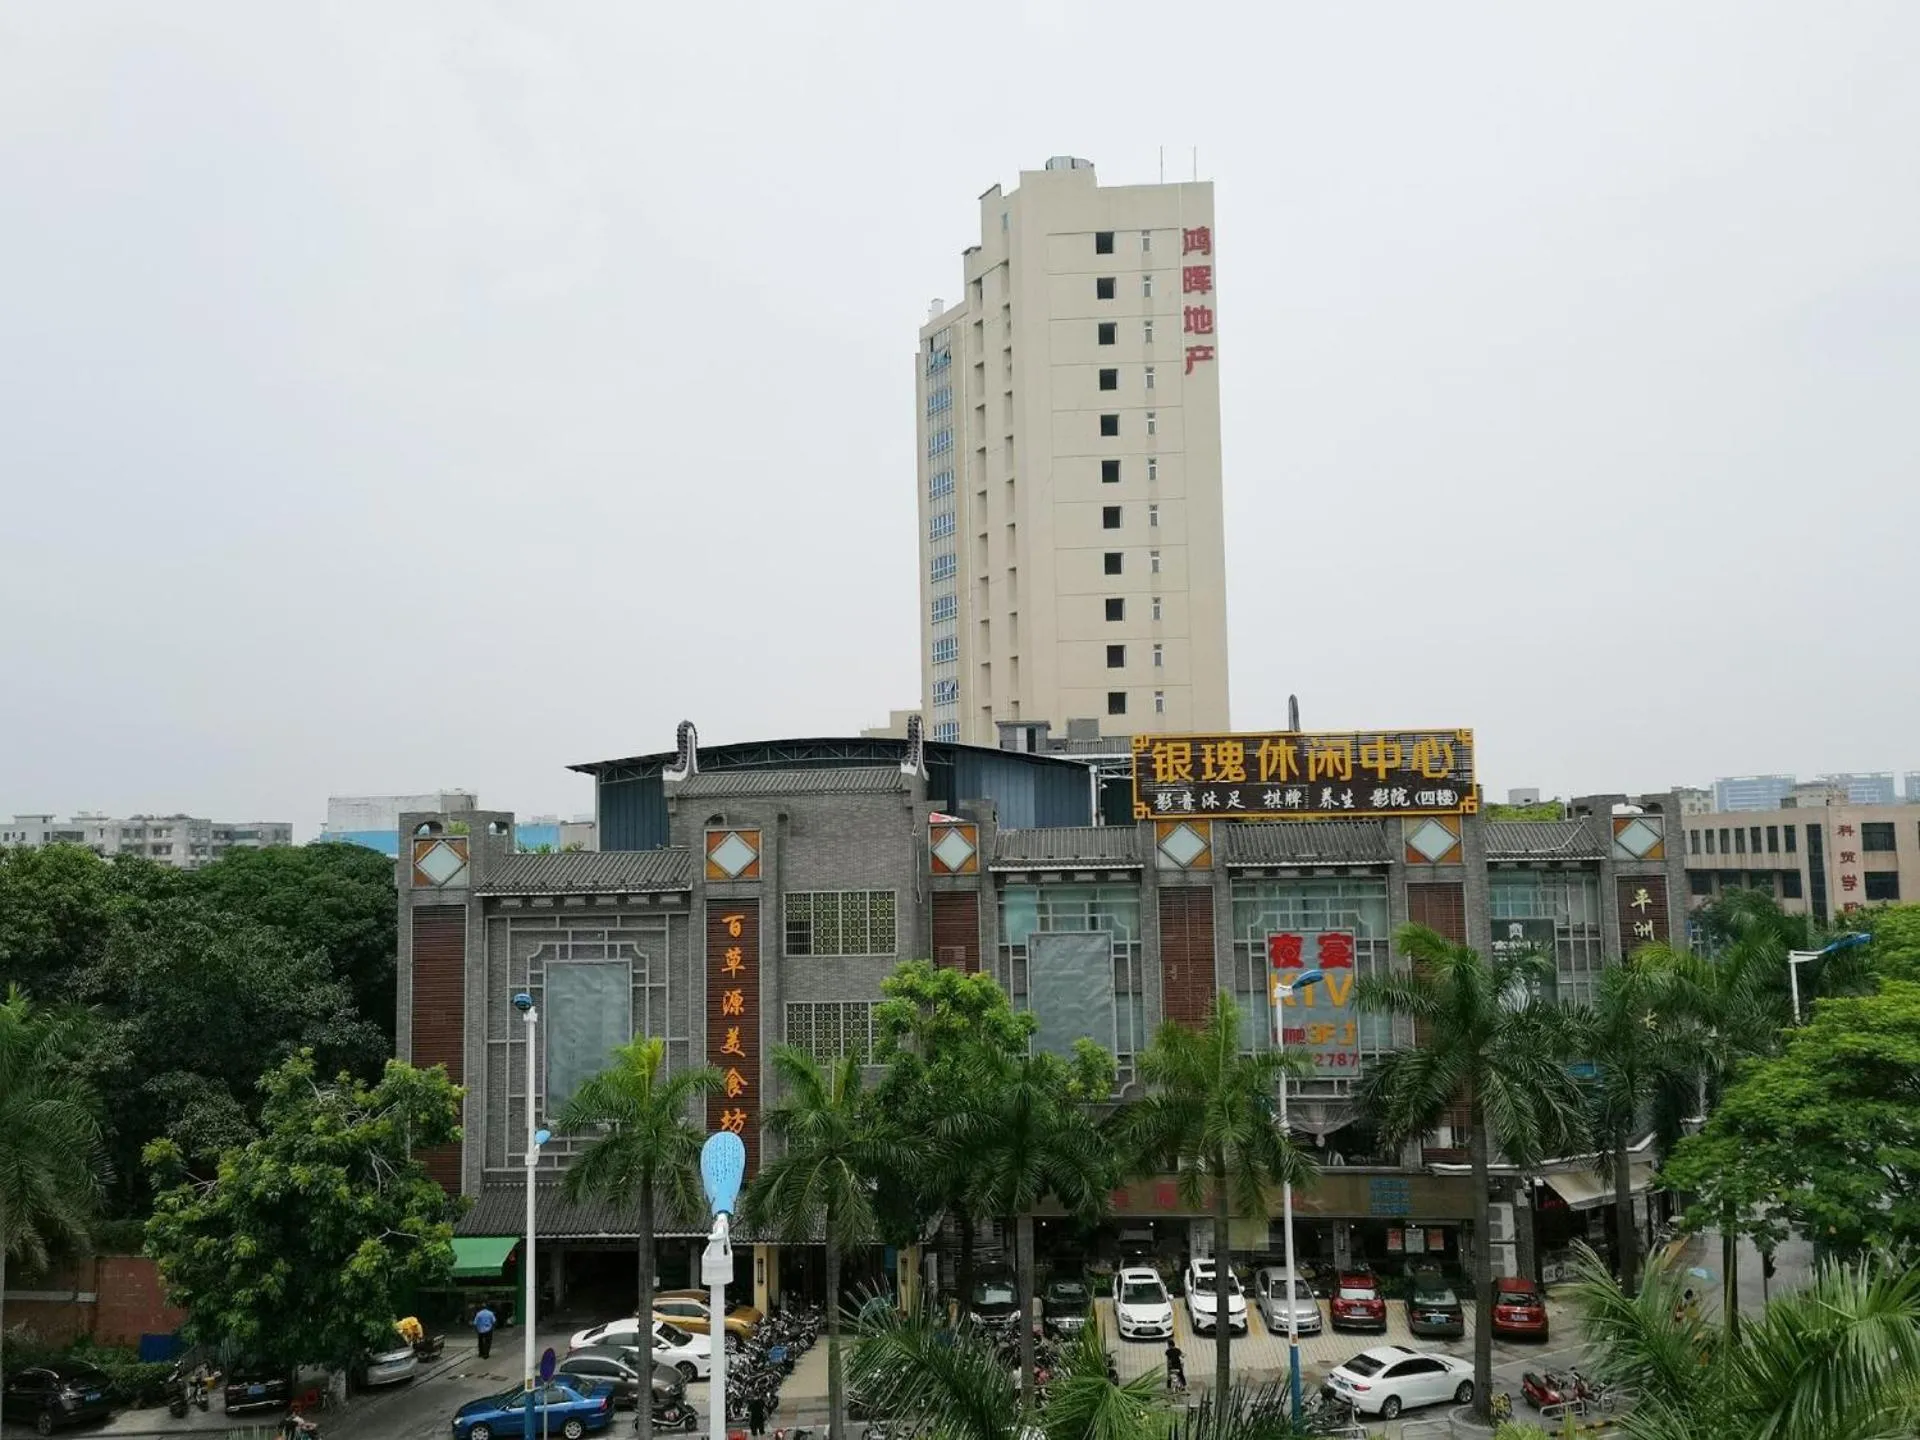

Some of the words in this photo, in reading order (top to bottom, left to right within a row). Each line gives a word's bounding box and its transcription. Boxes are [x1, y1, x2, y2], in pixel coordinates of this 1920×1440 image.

[1182, 226, 1214, 375] 鸿晖地产
[1151, 737, 1455, 783] 银瑰休闲中心
[1154, 790, 1245, 811] 影音沐足
[1262, 788, 1304, 809] 棋牌
[1319, 786, 1356, 810] 养生
[720, 914, 748, 1134] 百草源美食坊
